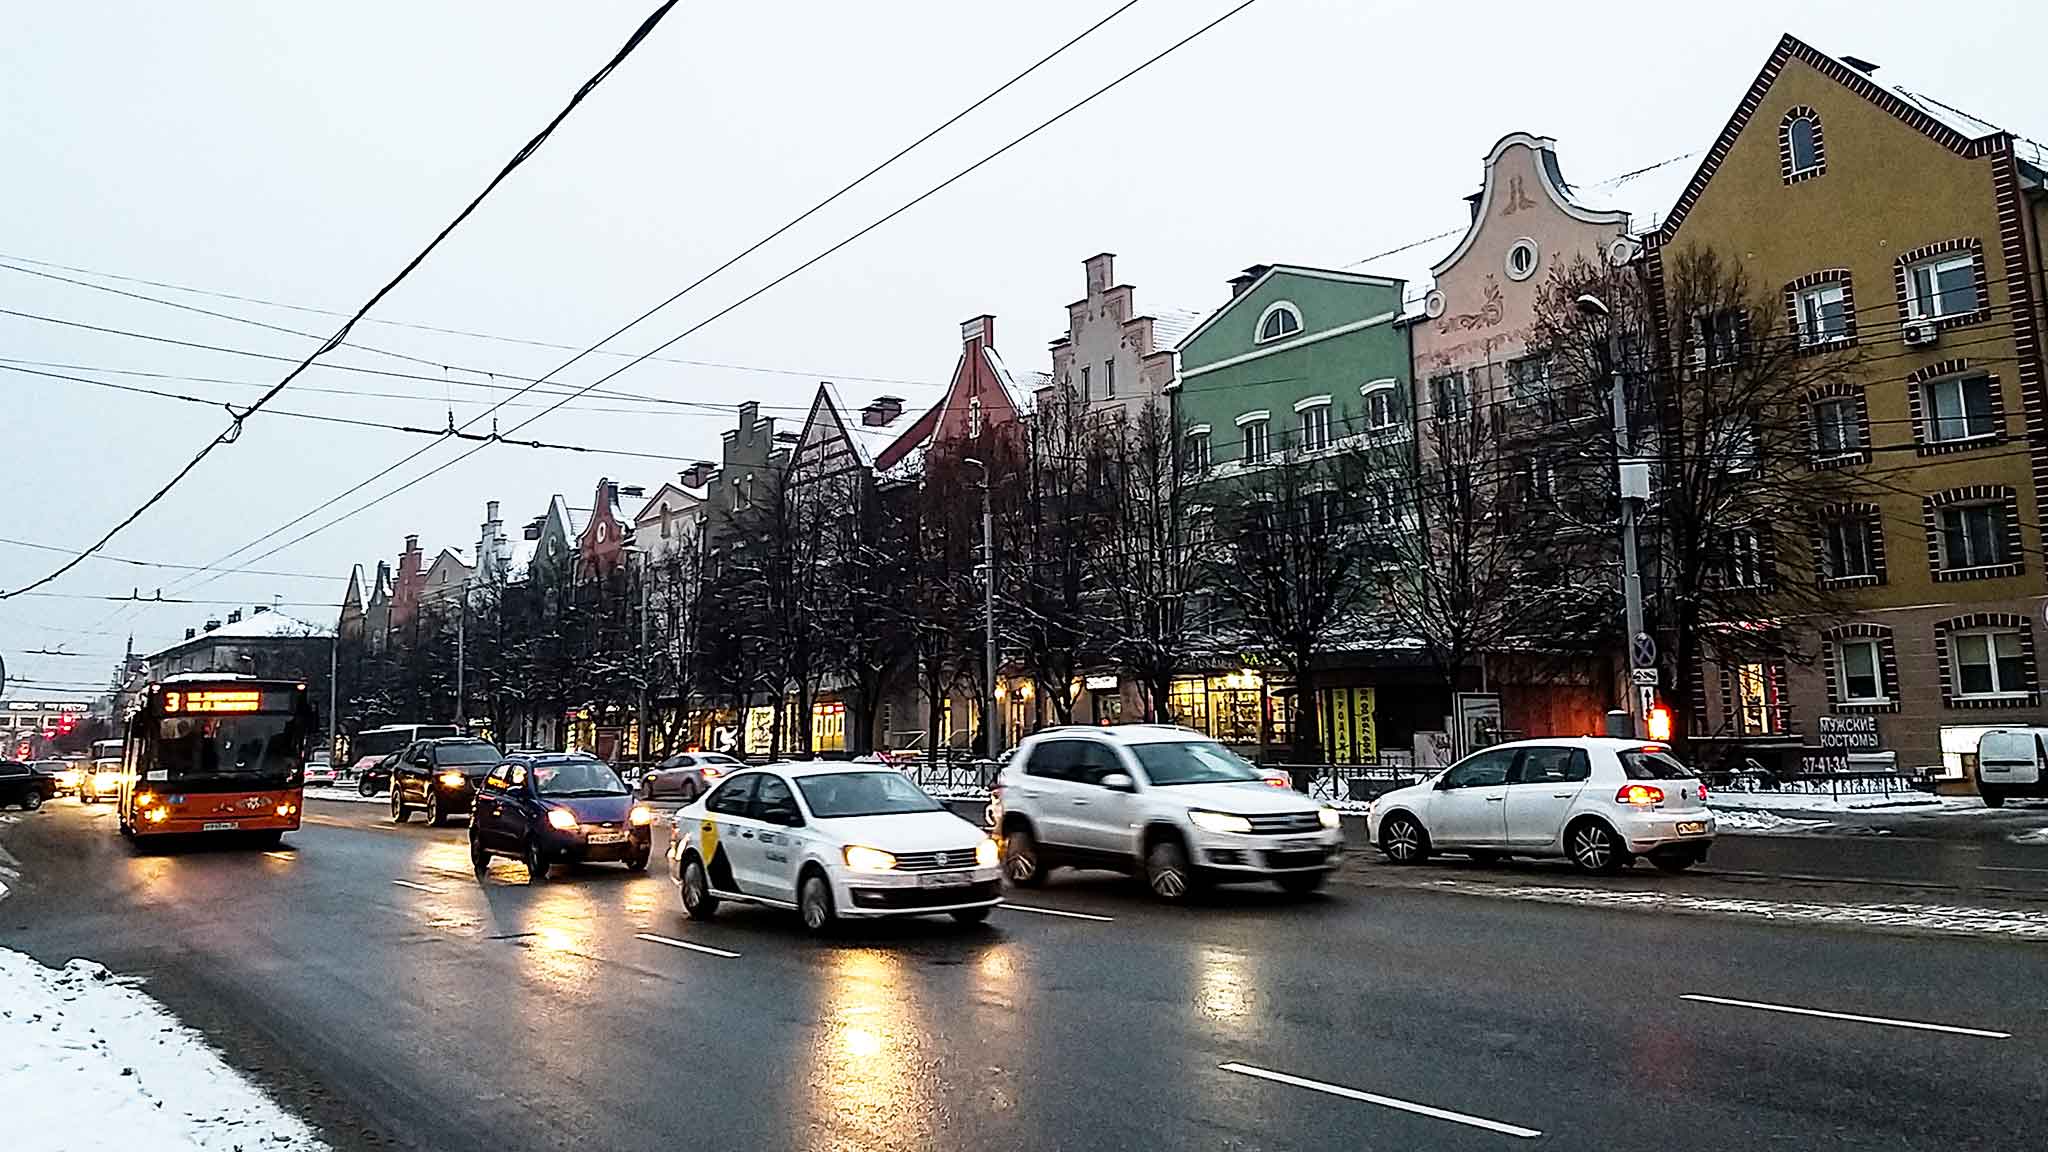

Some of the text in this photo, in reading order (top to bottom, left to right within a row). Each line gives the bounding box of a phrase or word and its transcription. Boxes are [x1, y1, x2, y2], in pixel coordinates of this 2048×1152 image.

[164, 692, 180, 712] 3
[1820, 718, 1876, 732] МУЖСКИЕ
[1820, 733, 1879, 747] КОСТЮМЫ
[1802, 756, 1847, 773] 37-41-34
